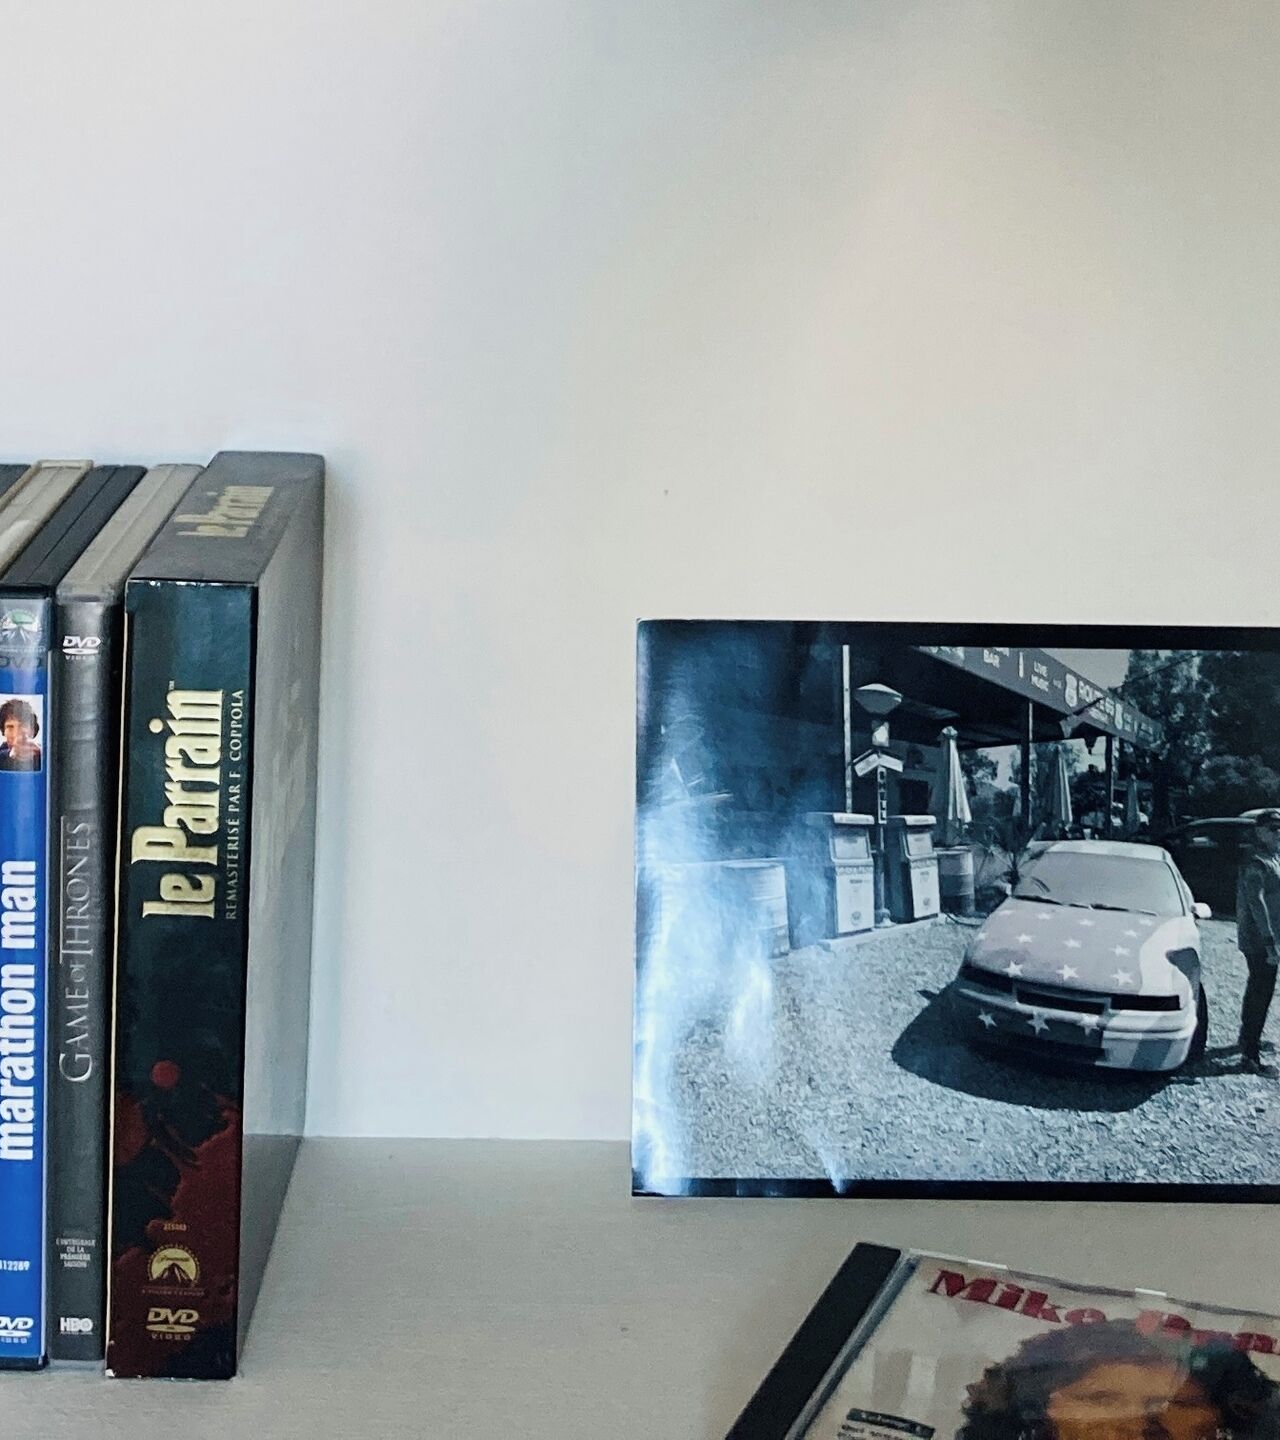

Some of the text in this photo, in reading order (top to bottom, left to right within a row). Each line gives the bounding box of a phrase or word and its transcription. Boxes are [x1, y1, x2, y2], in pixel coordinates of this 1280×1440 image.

[62, 636, 102, 648] DVD
[130, 689, 224, 920] le Parrain
[223, 689, 245, 920] REMASTERISÉ PAR COPPOLA
[0, 859, 37, 951] man
[58, 815, 96, 1083] GAME THRONES
[60, 1317, 94, 1332] HBO
[147, 1308, 200, 1323] DVD
[927, 1269, 1108, 1326] Mike
